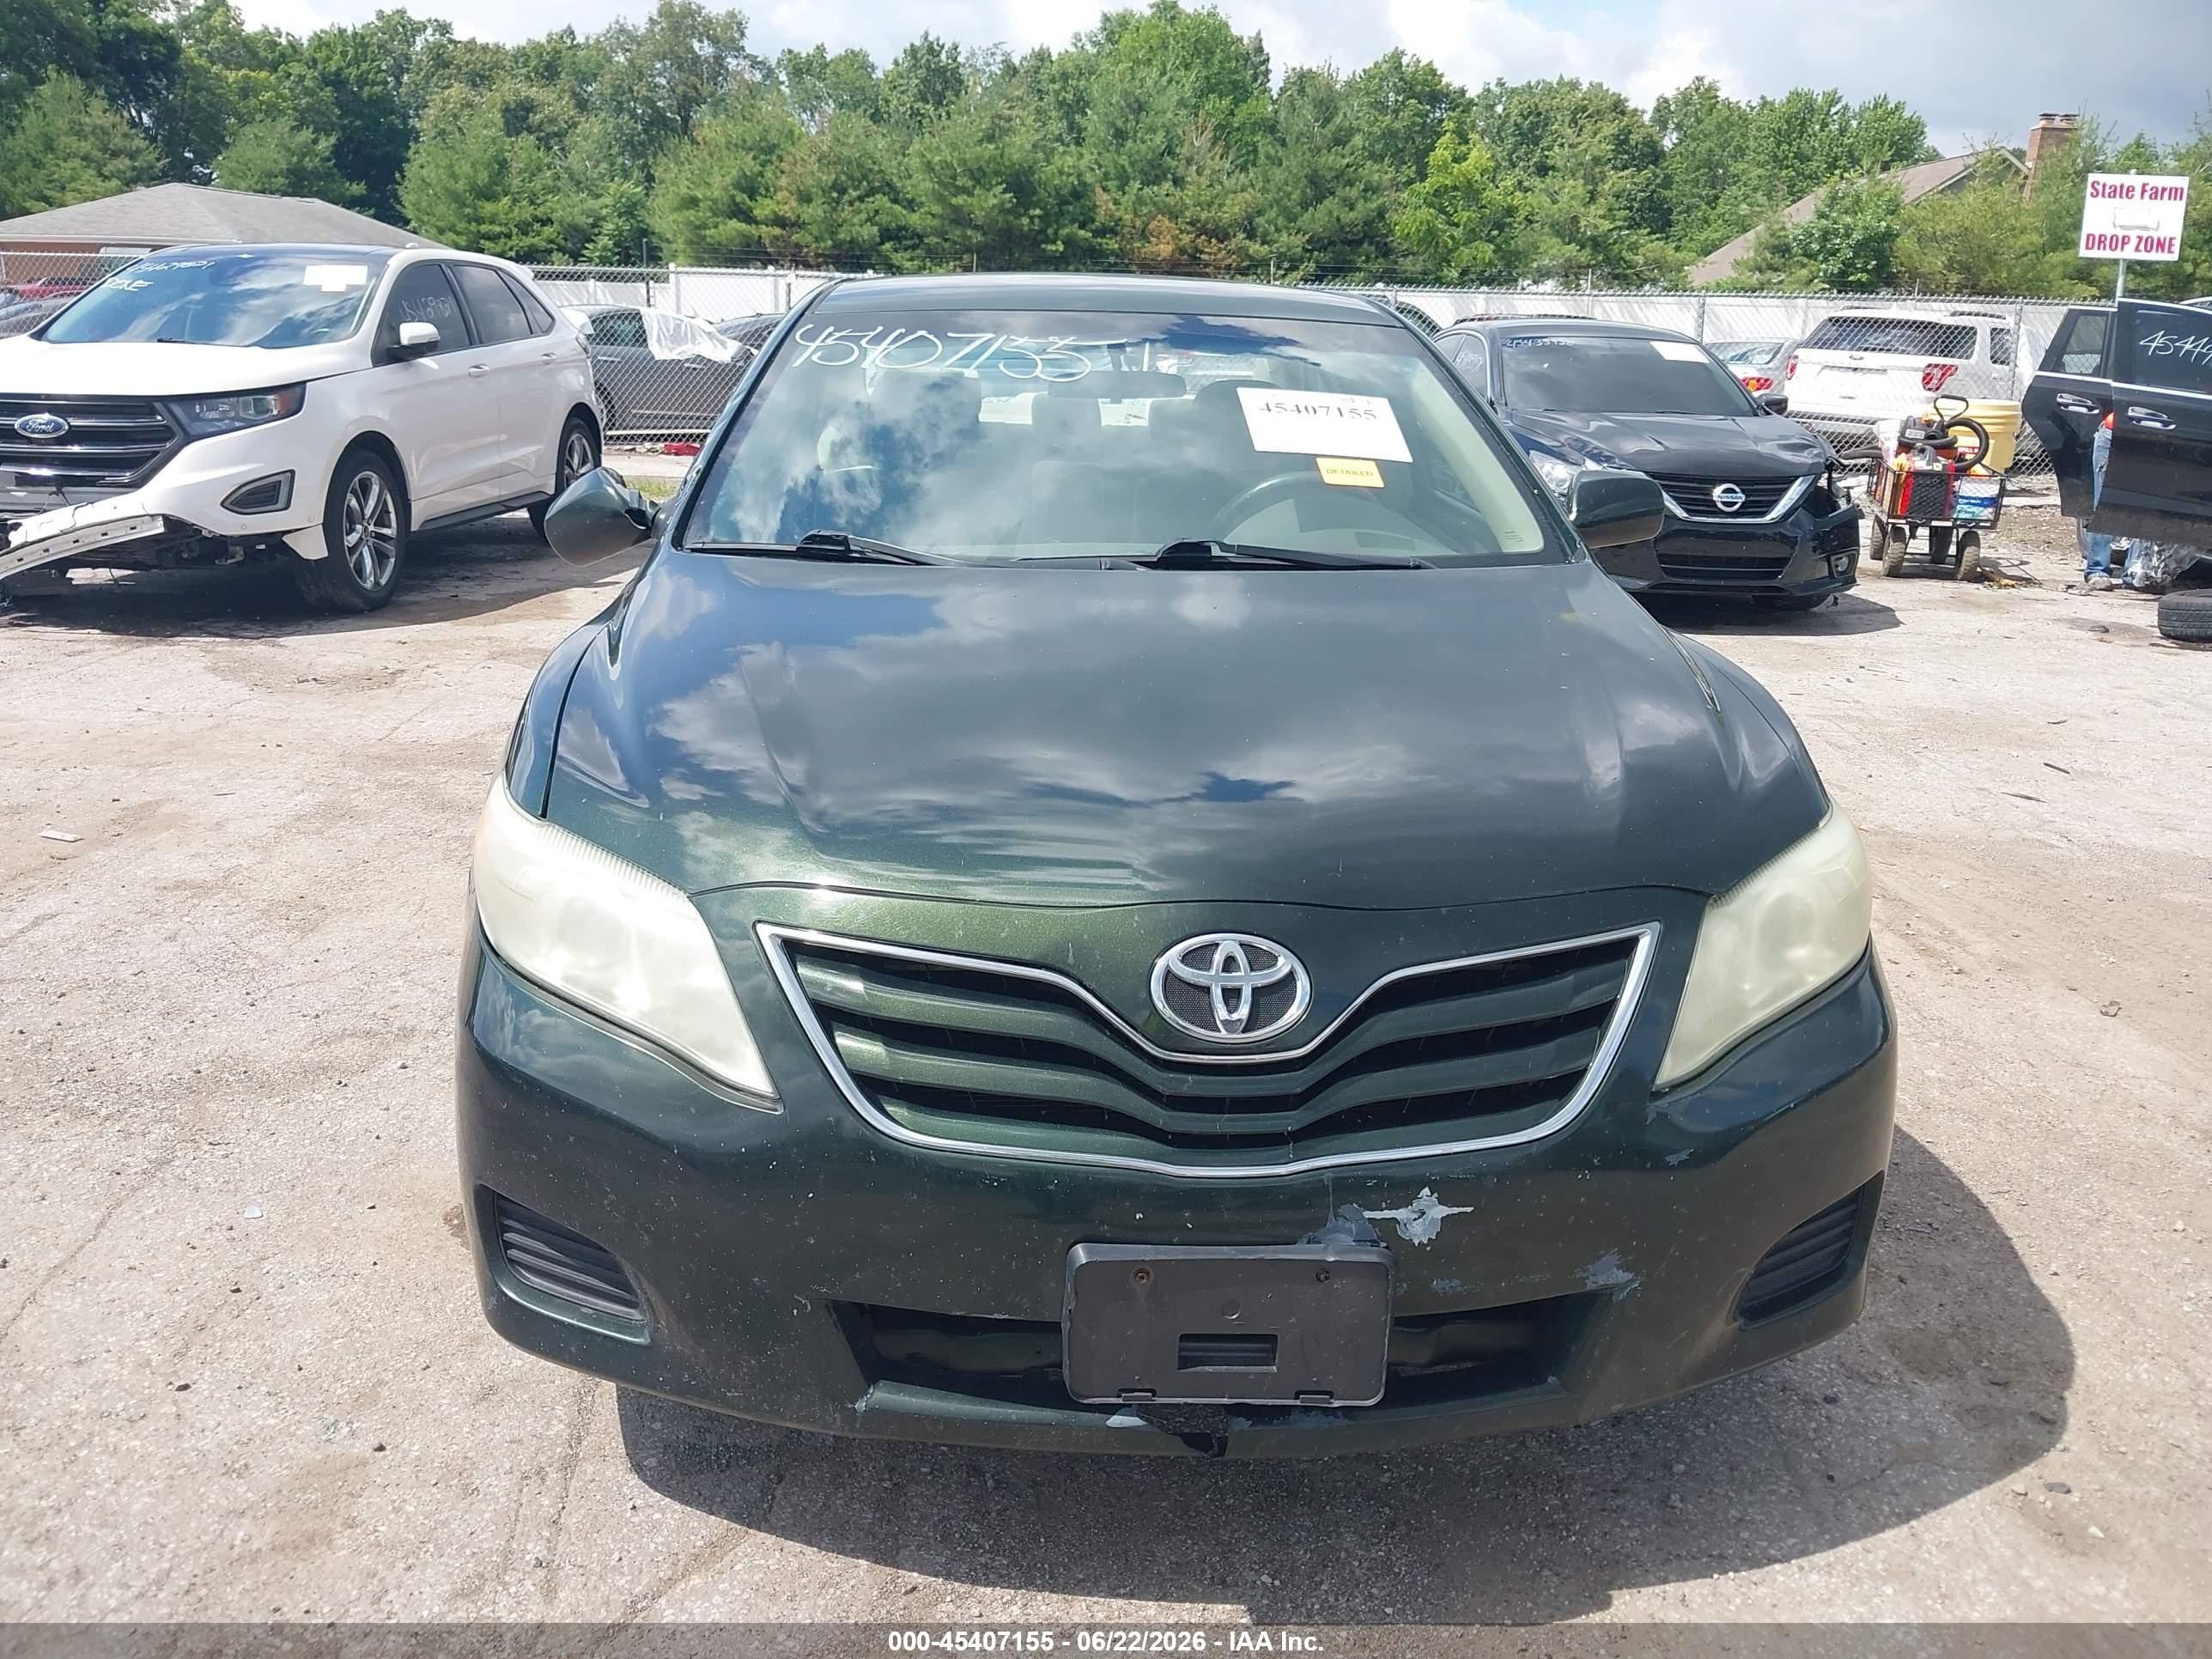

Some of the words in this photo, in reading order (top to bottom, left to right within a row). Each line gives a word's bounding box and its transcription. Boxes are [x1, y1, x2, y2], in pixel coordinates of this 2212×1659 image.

[2090, 180, 2136, 200] State
[2141, 182, 2185, 202] Farm
[2085, 234, 2131, 252] DROP
[2134, 235, 2177, 254] ZONE
[793, 324, 1127, 382] 45407155
[1259, 402, 1377, 421] 45407155
[26, 418, 55, 433] Ford
